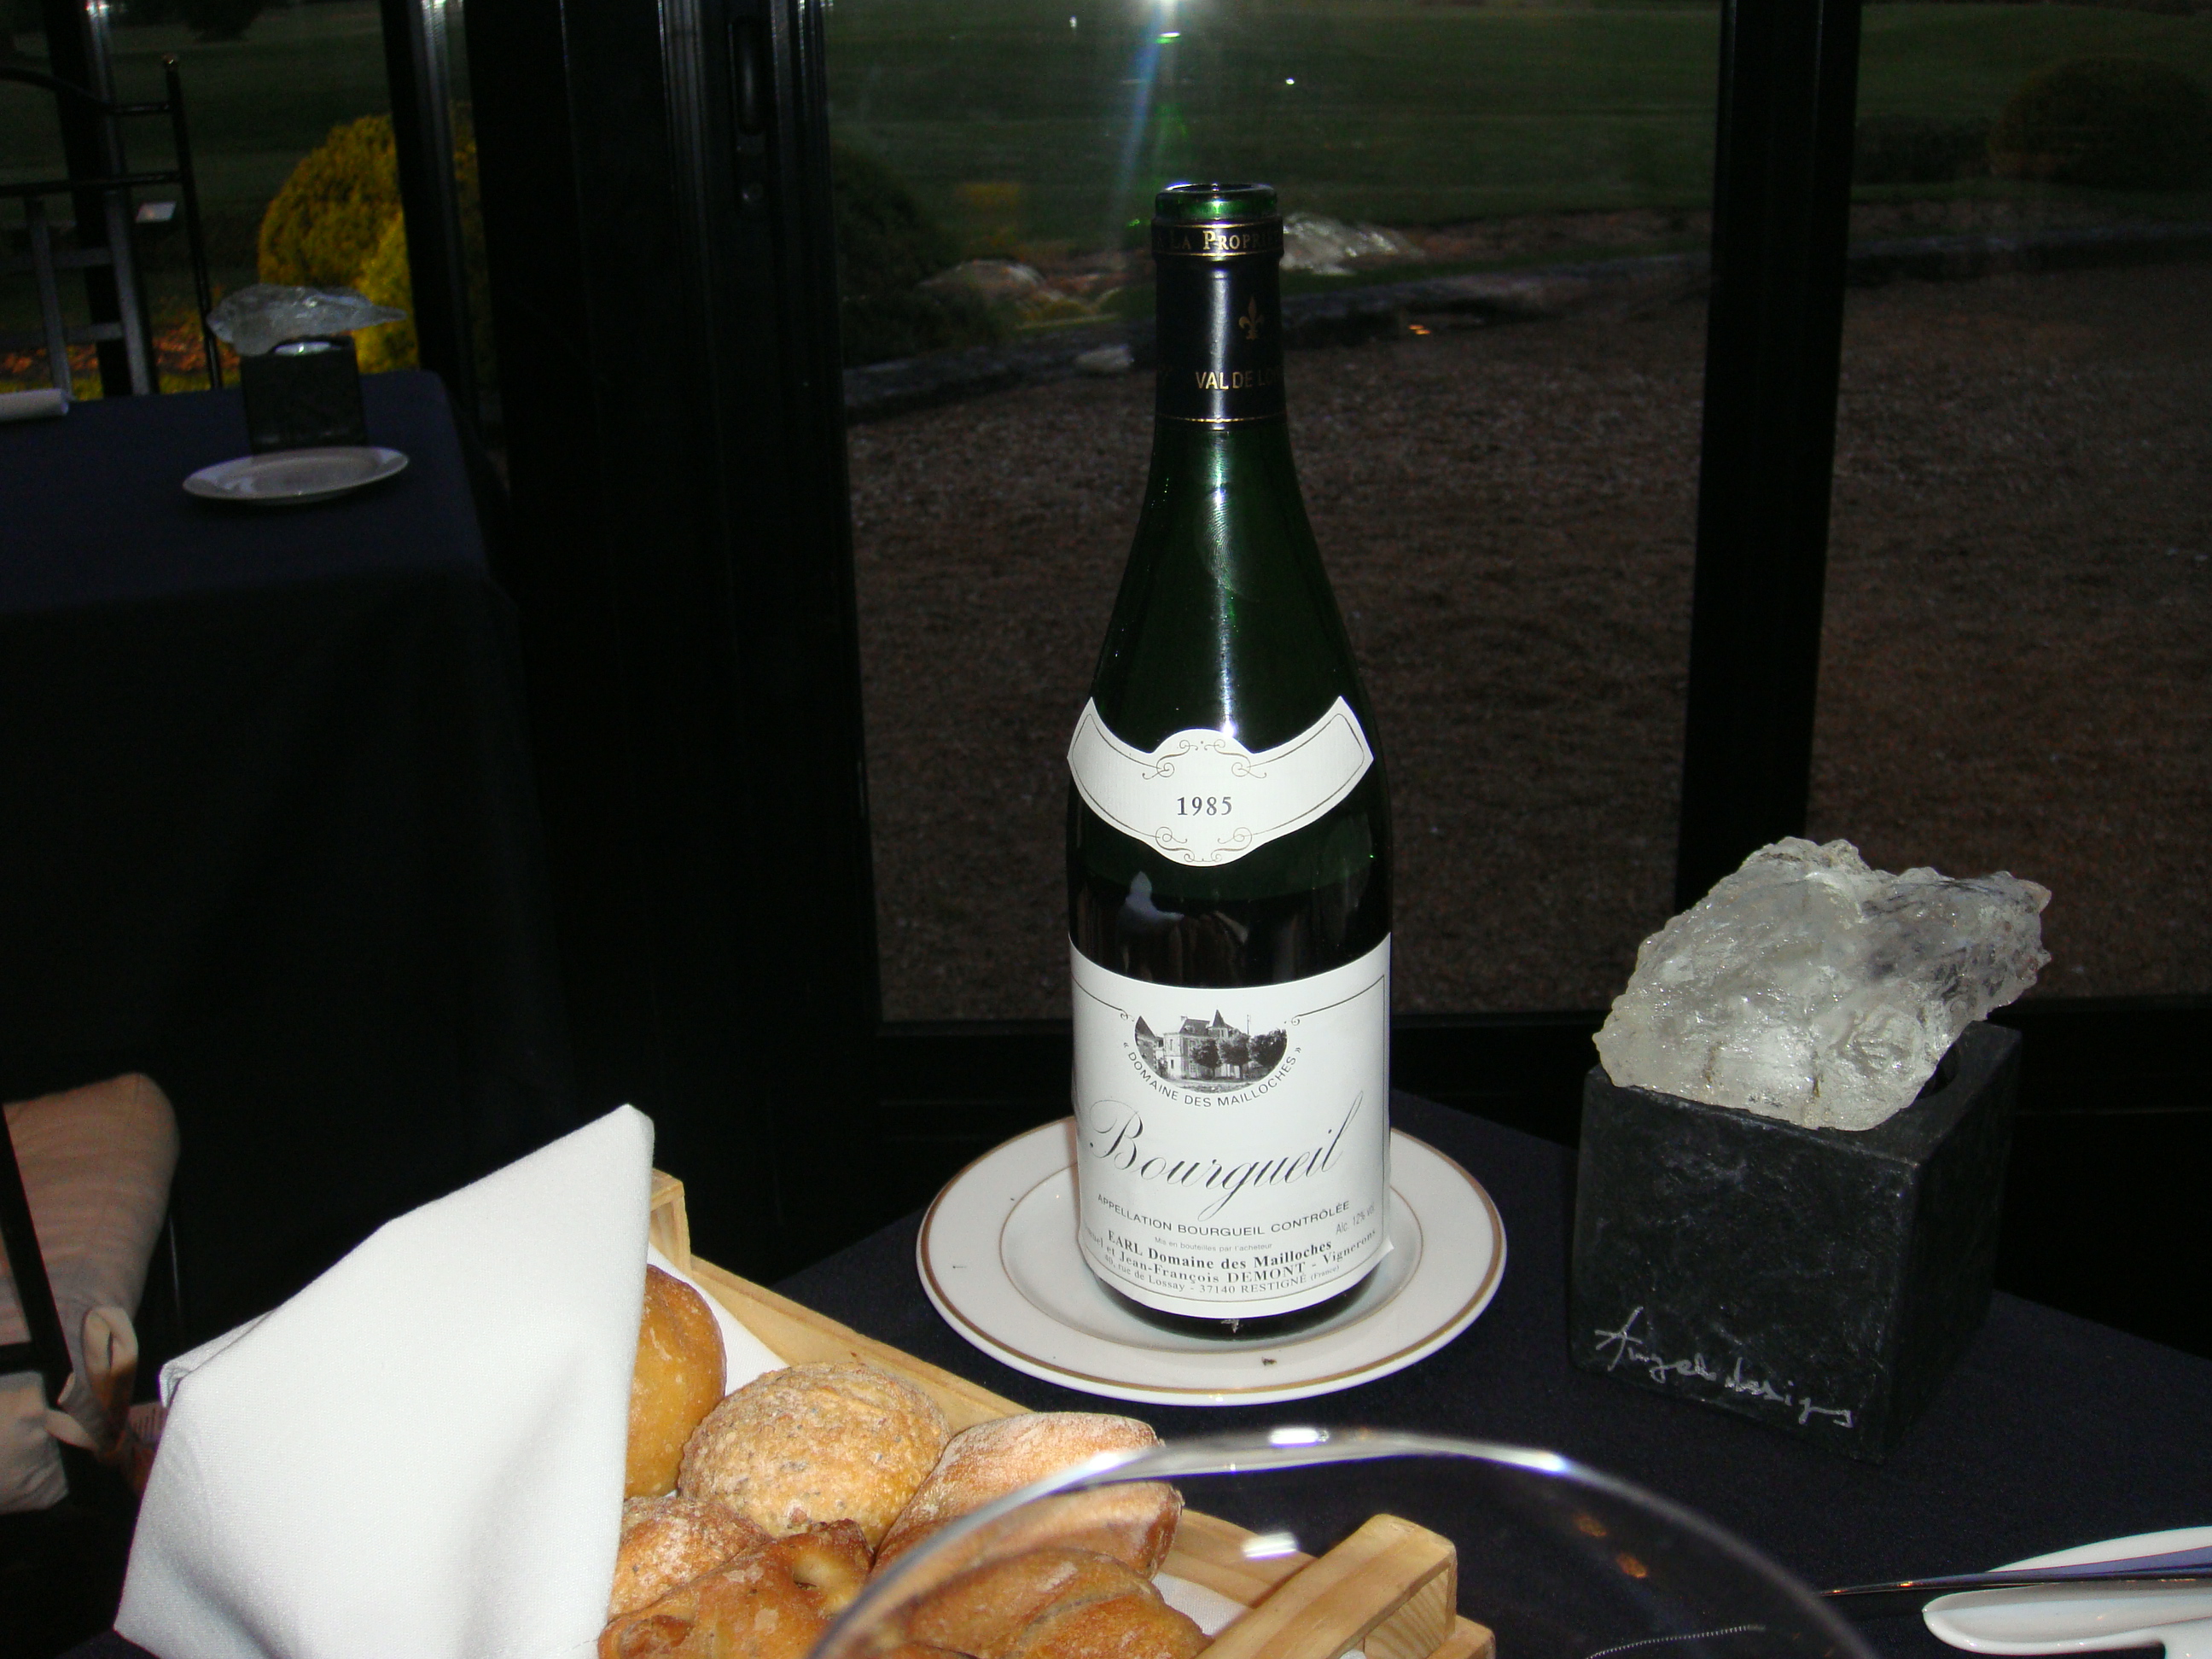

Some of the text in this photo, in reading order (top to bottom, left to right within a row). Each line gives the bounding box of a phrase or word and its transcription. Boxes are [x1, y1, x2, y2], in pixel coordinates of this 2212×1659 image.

[1195, 370, 1229, 390] VAL
[1231, 370, 1254, 389] DE
[1177, 795, 1232, 817] 1985
[1127, 1051, 1179, 1101] DOMAINE
[1184, 1094, 1212, 1108] DES
[1217, 1055, 1296, 1108] MAILLOCHES
[1089, 1091, 1364, 1222] Bourgueil
[1097, 1193, 1350, 1237] APPELLATION BOURGUEIL CONTRÔLÉE
[1335, 1221, 1349, 1235] Alc.
[1353, 1211, 1366, 1226] 12%
[1108, 1229, 1333, 1270] EARL Domaine des Mailloches
[1155, 1237, 1167, 1246] Mis
[1180, 1242, 1217, 1252] bouteilles
[1219, 1245, 1232, 1254] par
[1234, 1243, 1273, 1253] l'acheteur
[1106, 1245, 1115, 1258] et
[1119, 1250, 1220, 1285] Jean-François
[1227, 1261, 1307, 1284] DEMONT
[1118, 1263, 1132, 1275] rue
[1134, 1270, 1145, 1281] de
[1149, 1274, 1185, 1293] Lossay
[1199, 1285, 1236, 1295] 37140
[1240, 1272, 1307, 1295] RESTIGNÉ
[1310, 1264, 1341, 1282] (France)
